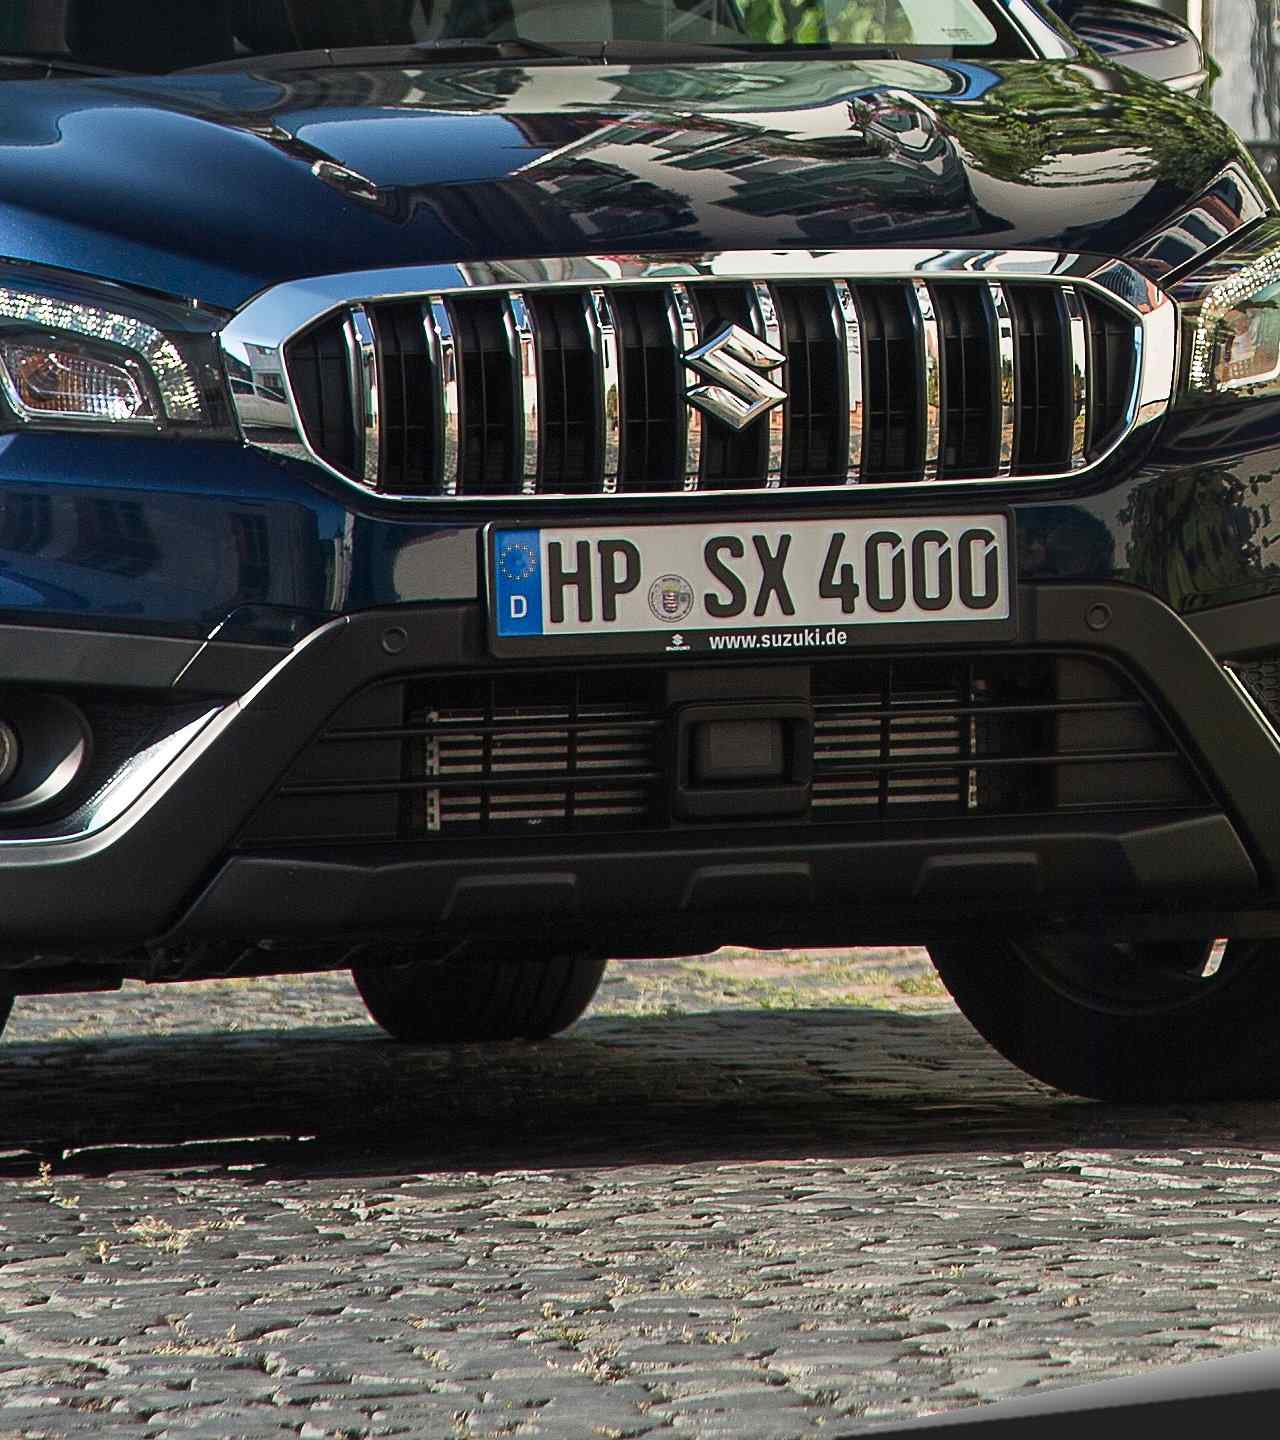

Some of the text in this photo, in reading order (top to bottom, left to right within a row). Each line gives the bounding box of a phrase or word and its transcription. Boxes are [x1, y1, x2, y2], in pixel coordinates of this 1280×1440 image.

[548, 539, 641, 623] HP
[704, 534, 796, 618] SX
[819, 528, 999, 614] 4000
[510, 596, 528, 618] D
[709, 628, 848, 650] www.suzuki.de
